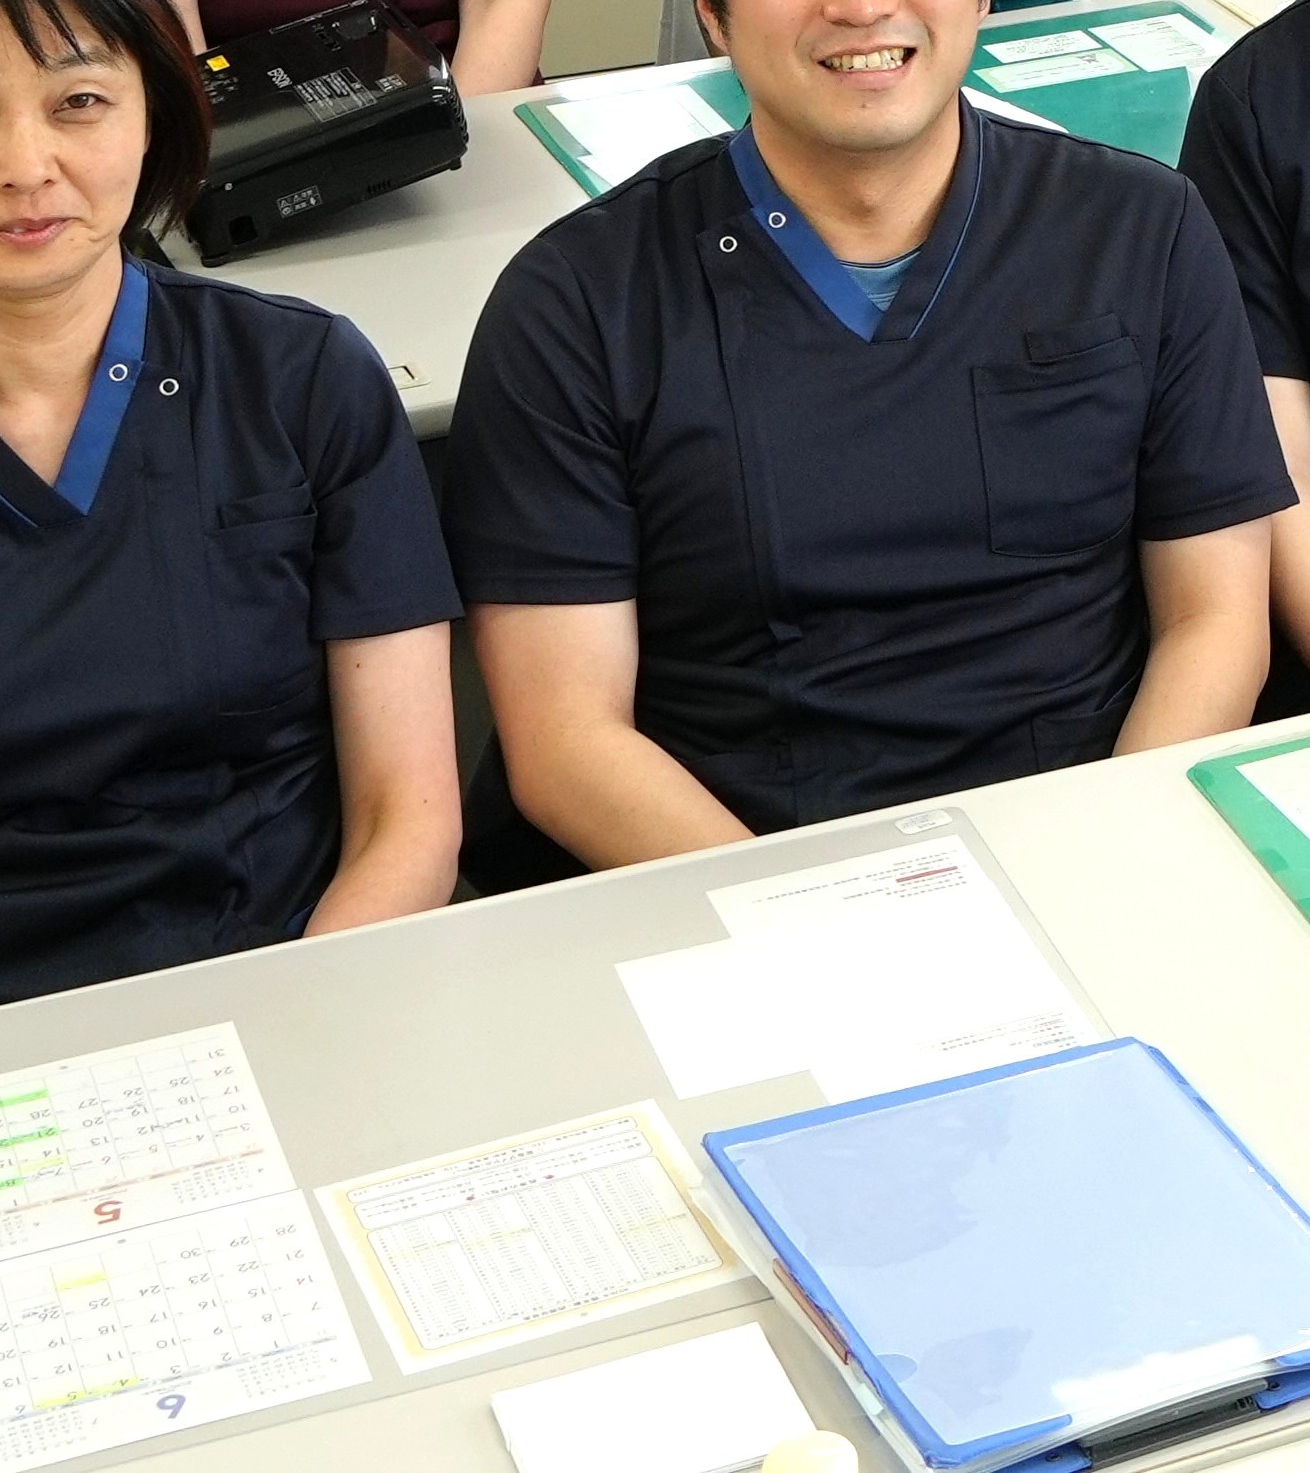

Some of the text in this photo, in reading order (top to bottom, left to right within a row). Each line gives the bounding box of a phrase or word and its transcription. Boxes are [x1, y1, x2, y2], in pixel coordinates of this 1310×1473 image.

[267, 67, 293, 88] EPSON
[29, 1066, 233, 1119] 24 25 26 27 28
[223, 1085, 240, 1095] 17
[177, 1095, 196, 1105] 18
[228, 1103, 247, 1114] 10
[82, 1117, 104, 1127] 20
[89, 1136, 110, 1146] 13
[42, 1147, 61, 1158] 14
[93, 1200, 124, 1225] 5
[230, 1236, 250, 1248] 29
[180, 1247, 201, 1260] 30
[237, 1261, 259, 1273] 22
[188, 1273, 209, 1285] 23
[138, 1285, 161, 1297] 24
[248, 1287, 267, 1298] 15
[88, 1298, 110, 1310] 25
[198, 1300, 217, 1310] 16
[150, 1311, 168, 1324] 17
[98, 1325, 117, 1336] 18
[47, 1337, 66, 1348] 19
[156, 1337, 177, 1349] 10
[105, 1350, 123, 1361] 11
[55, 1364, 74, 1375] 12
[1, 1377, 22, 1388] 13
[156, 1395, 186, 1420] 6
